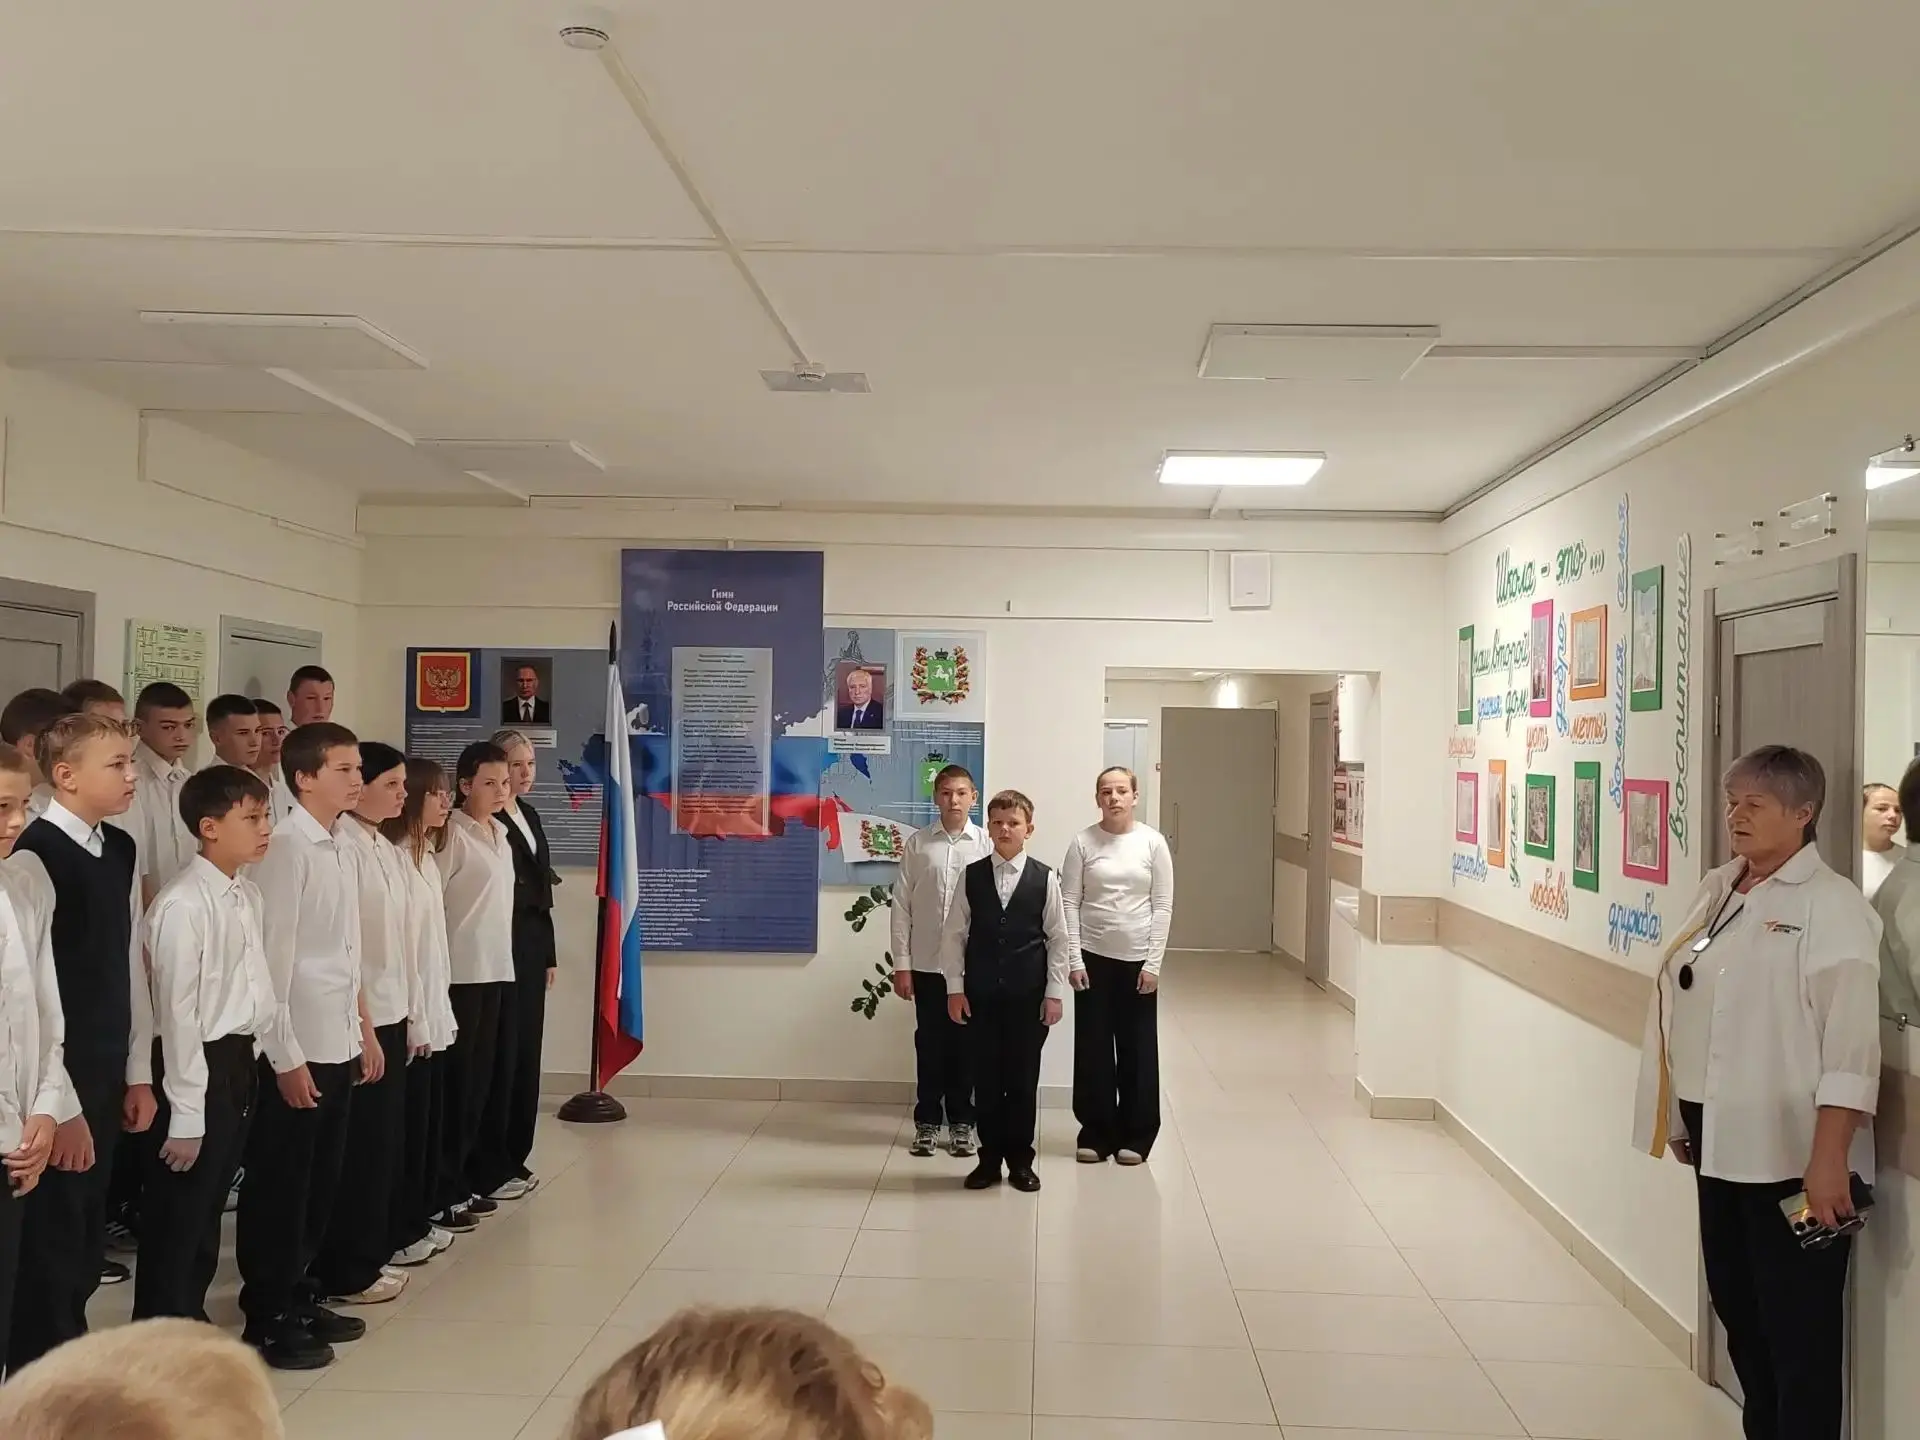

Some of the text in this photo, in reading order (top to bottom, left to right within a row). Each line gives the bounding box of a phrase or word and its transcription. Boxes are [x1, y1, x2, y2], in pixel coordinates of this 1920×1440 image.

[711, 588, 734, 599] Гимн
[1496, 548, 1535, 603] Школа
[1556, 541, 1584, 582] это
[667, 600, 779, 613] Российской Федерации
[1490, 629, 1529, 687] второй
[1554, 613, 1570, 733] добро
[1608, 492, 1627, 810] большая семья
[1505, 688, 1528, 733] дом
[1669, 533, 1690, 852] воспитание
[1526, 725, 1548, 766] уют
[1571, 713, 1606, 740] мечты
[1608, 892, 1660, 951] дружба
